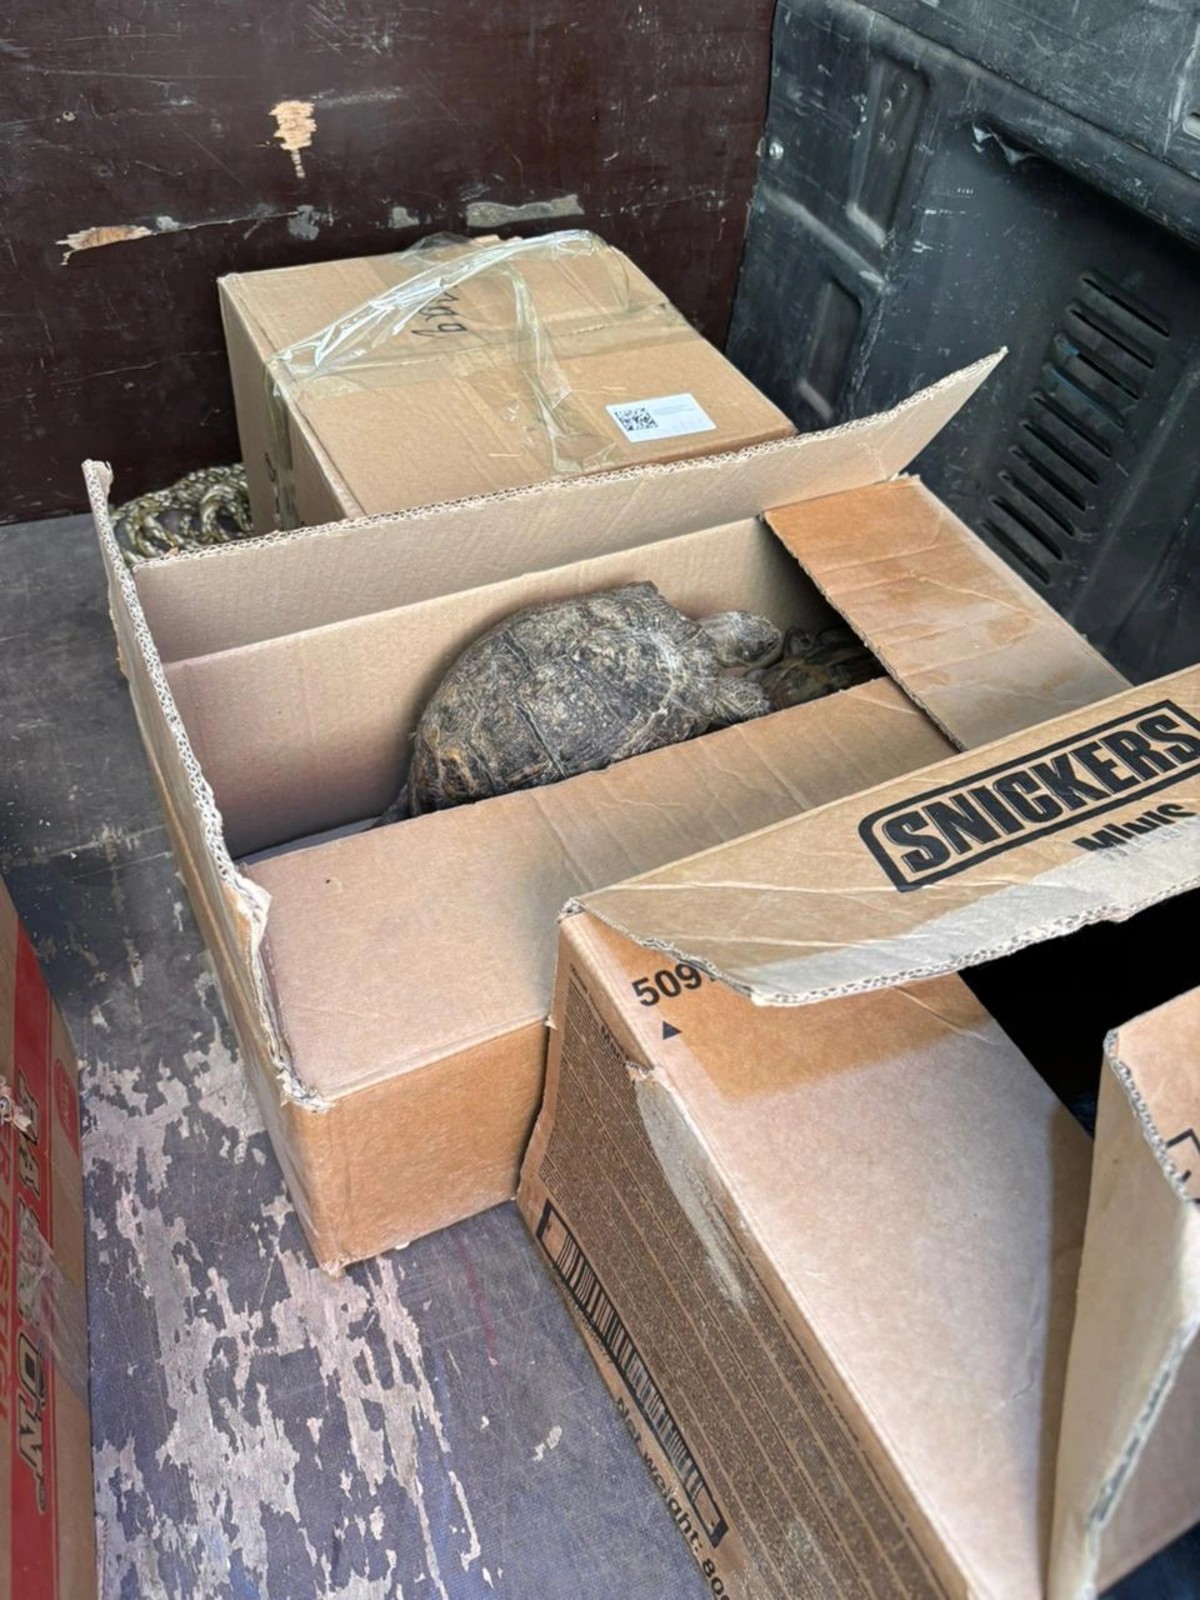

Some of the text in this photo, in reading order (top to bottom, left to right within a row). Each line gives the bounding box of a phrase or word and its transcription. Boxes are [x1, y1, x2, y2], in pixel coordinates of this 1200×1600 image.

[881, 714, 1200, 872] SNICKERS
[630, 962, 711, 1005] 509
[703, 1558, 730, 1600] 80
